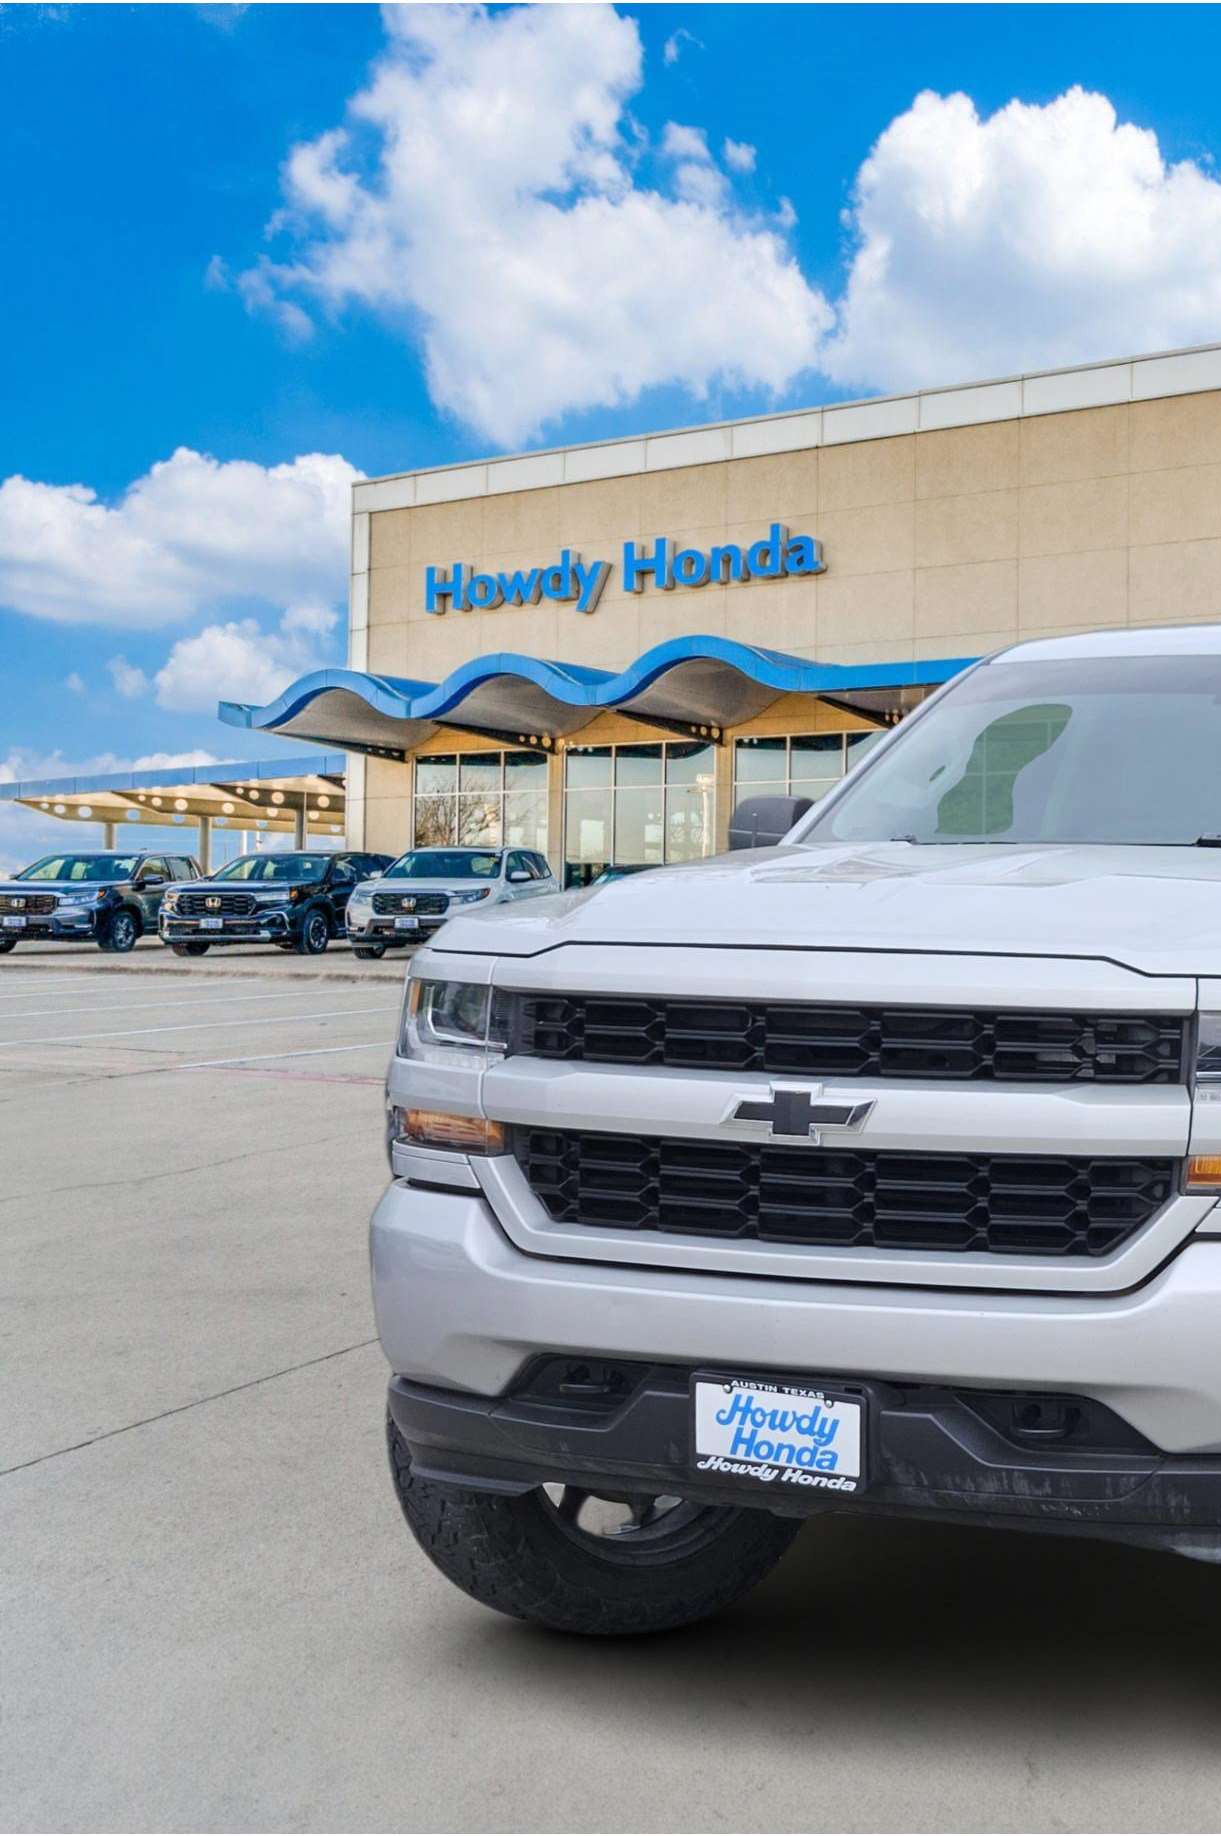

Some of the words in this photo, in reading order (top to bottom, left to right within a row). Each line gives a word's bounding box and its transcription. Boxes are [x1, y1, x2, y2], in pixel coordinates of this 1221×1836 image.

[425, 549, 612, 615] Howdy
[623, 523, 827, 594] Honda
[731, 1380, 777, 1393] AUSTIN
[782, 1387, 825, 1399] TEXAS
[716, 1394, 840, 1447] Howdy
[730, 1427, 839, 1471] Honda
[697, 1456, 779, 1482] Howdy
[781, 1469, 857, 1491] Honda
